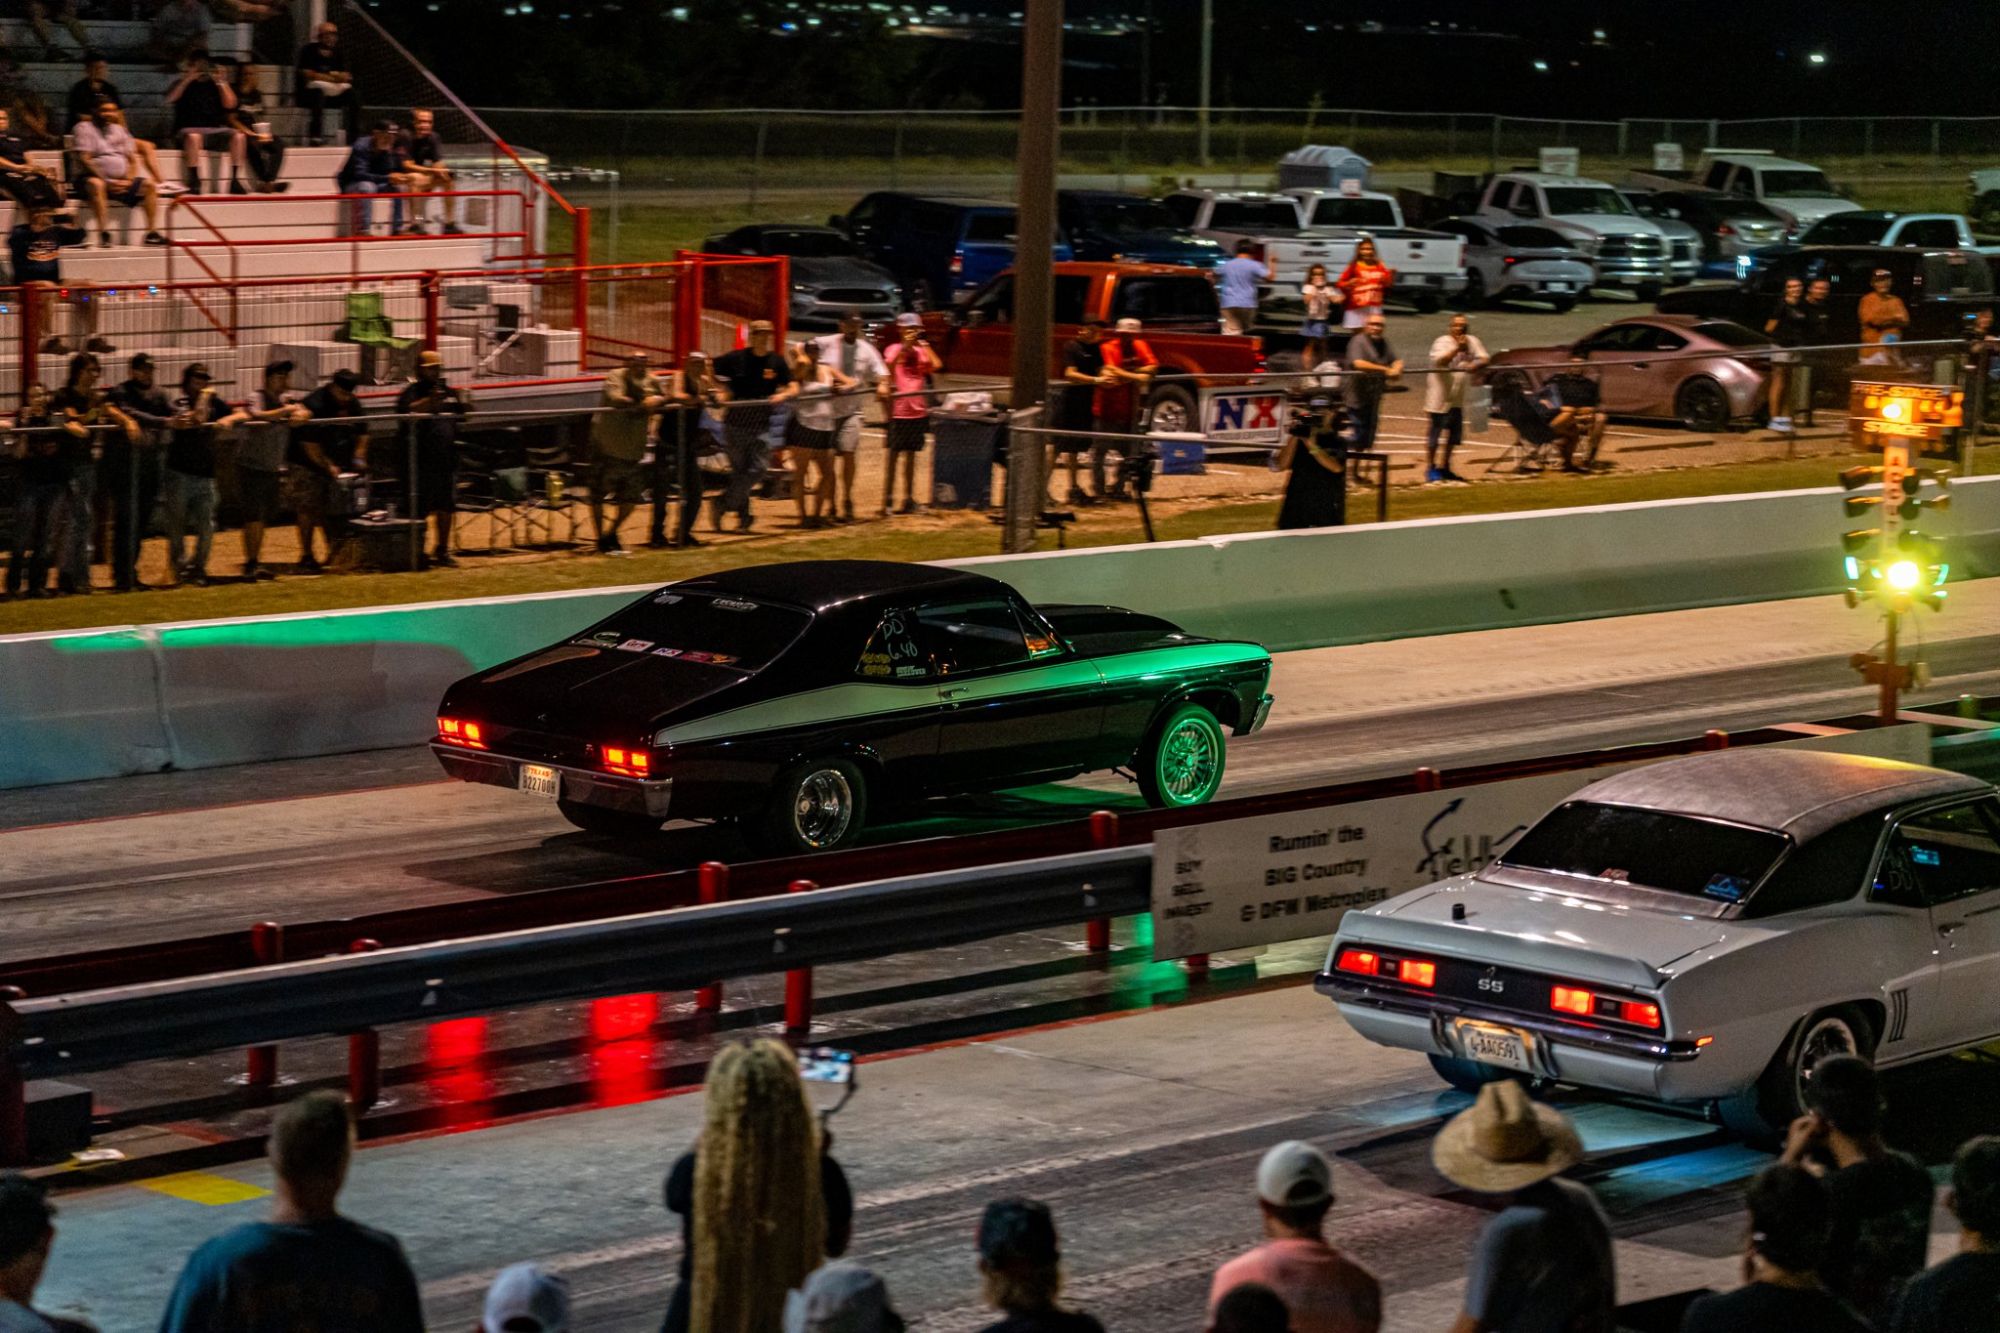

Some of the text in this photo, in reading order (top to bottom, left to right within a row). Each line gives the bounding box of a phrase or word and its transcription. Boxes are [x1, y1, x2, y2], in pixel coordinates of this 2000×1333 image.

[1215, 396, 1280, 430] NX
[1862, 421, 1929, 437] STAGE
[1338, 826, 1365, 843] the
[1175, 860, 1203, 875] BUY
[1265, 858, 1368, 886] BIG Country
[1172, 882, 1205, 897] SELL
[1240, 905, 1257, 922] &
[1260, 898, 1300, 920] DFW
[1478, 978, 1504, 993] SS
